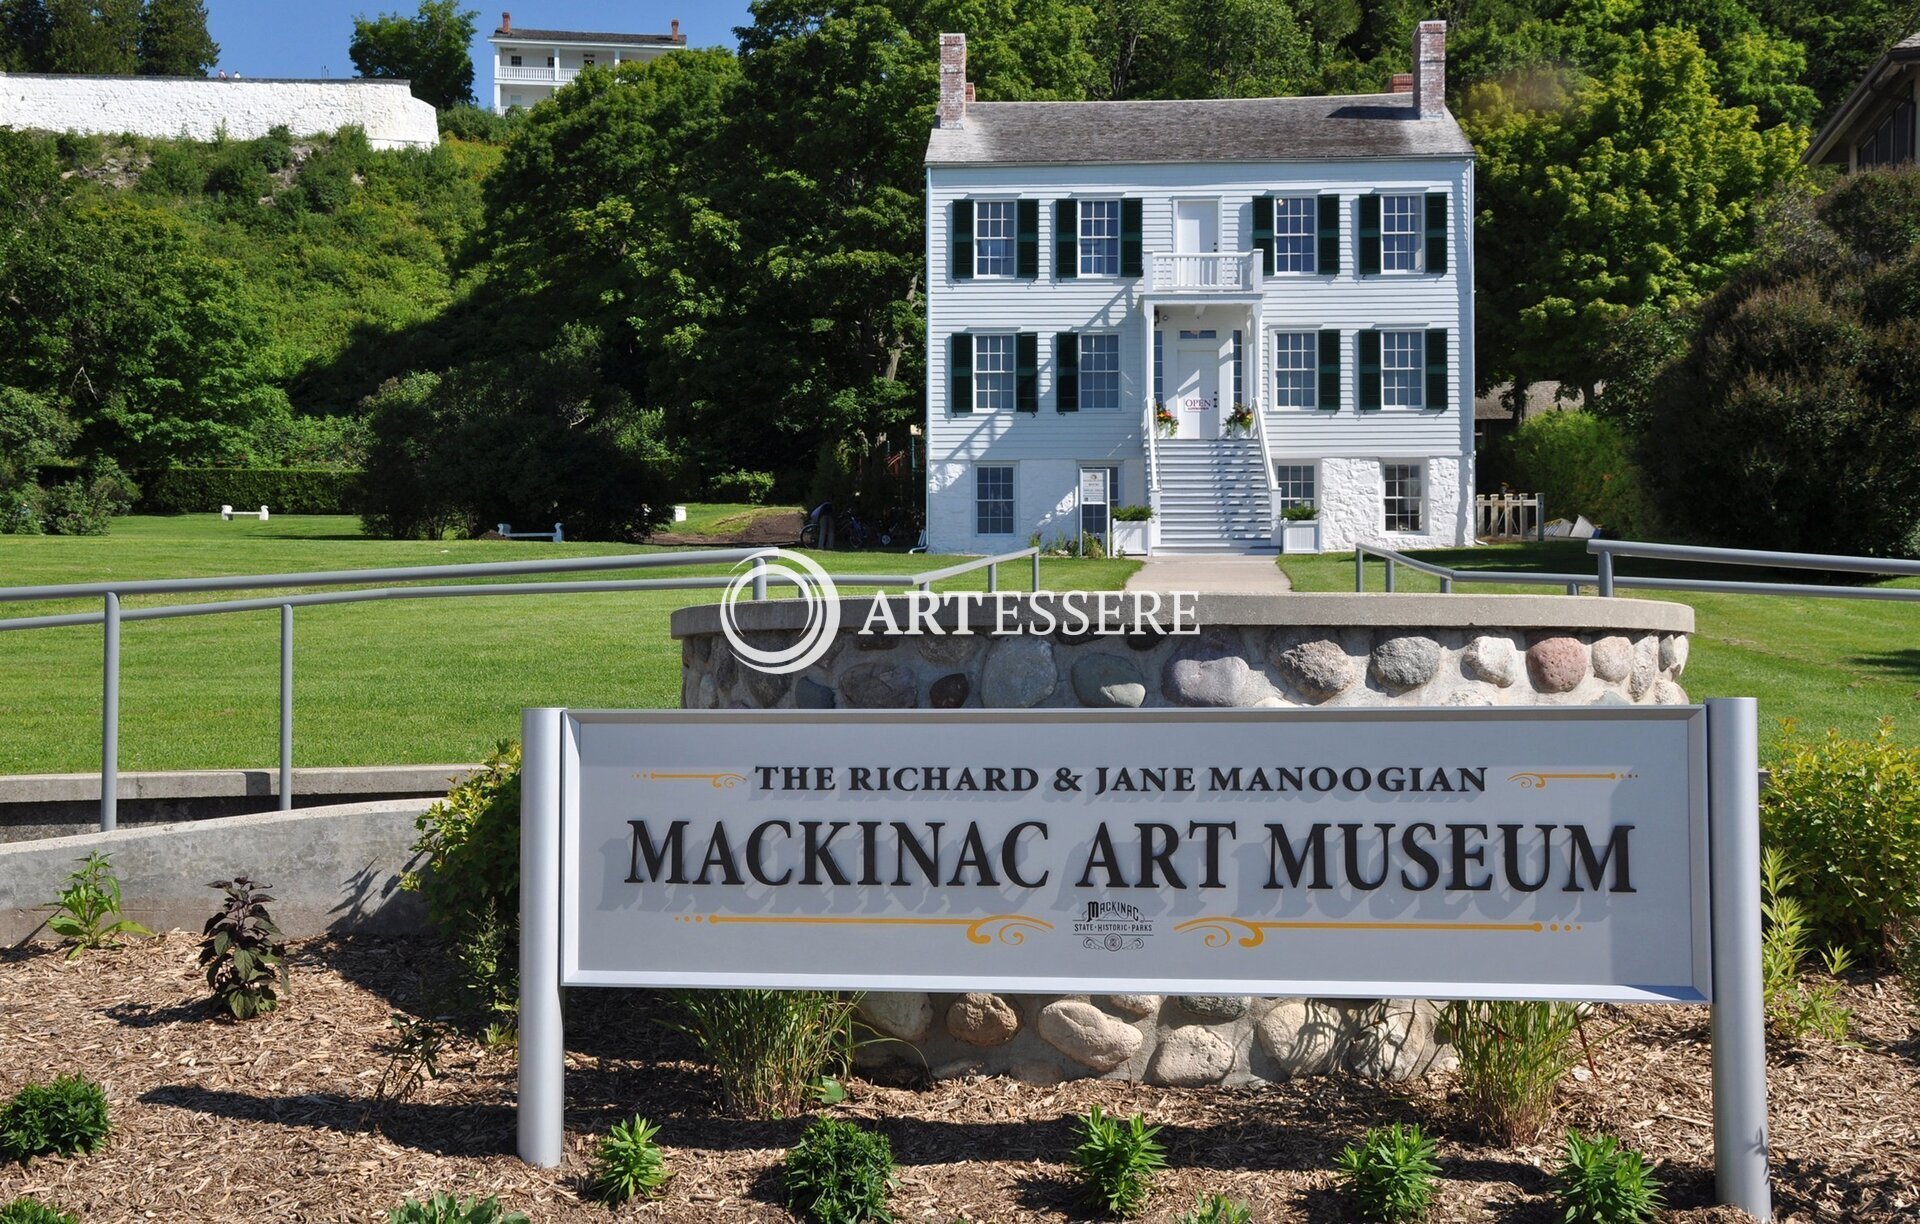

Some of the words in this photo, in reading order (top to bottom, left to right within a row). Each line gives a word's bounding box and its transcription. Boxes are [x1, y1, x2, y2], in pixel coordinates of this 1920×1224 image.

[755, 766, 837, 791] THE
[848, 766, 1039, 792] RICHARD
[1053, 766, 1083, 792] &
[1094, 766, 1196, 795] JANE
[1208, 766, 1488, 792] MANOOGIAN
[624, 820, 1050, 888] MACKINAC
[1075, 820, 1237, 890] ART
[1263, 822, 1637, 893] MUSEUM
[1087, 901, 1139, 922] MACKINAC
